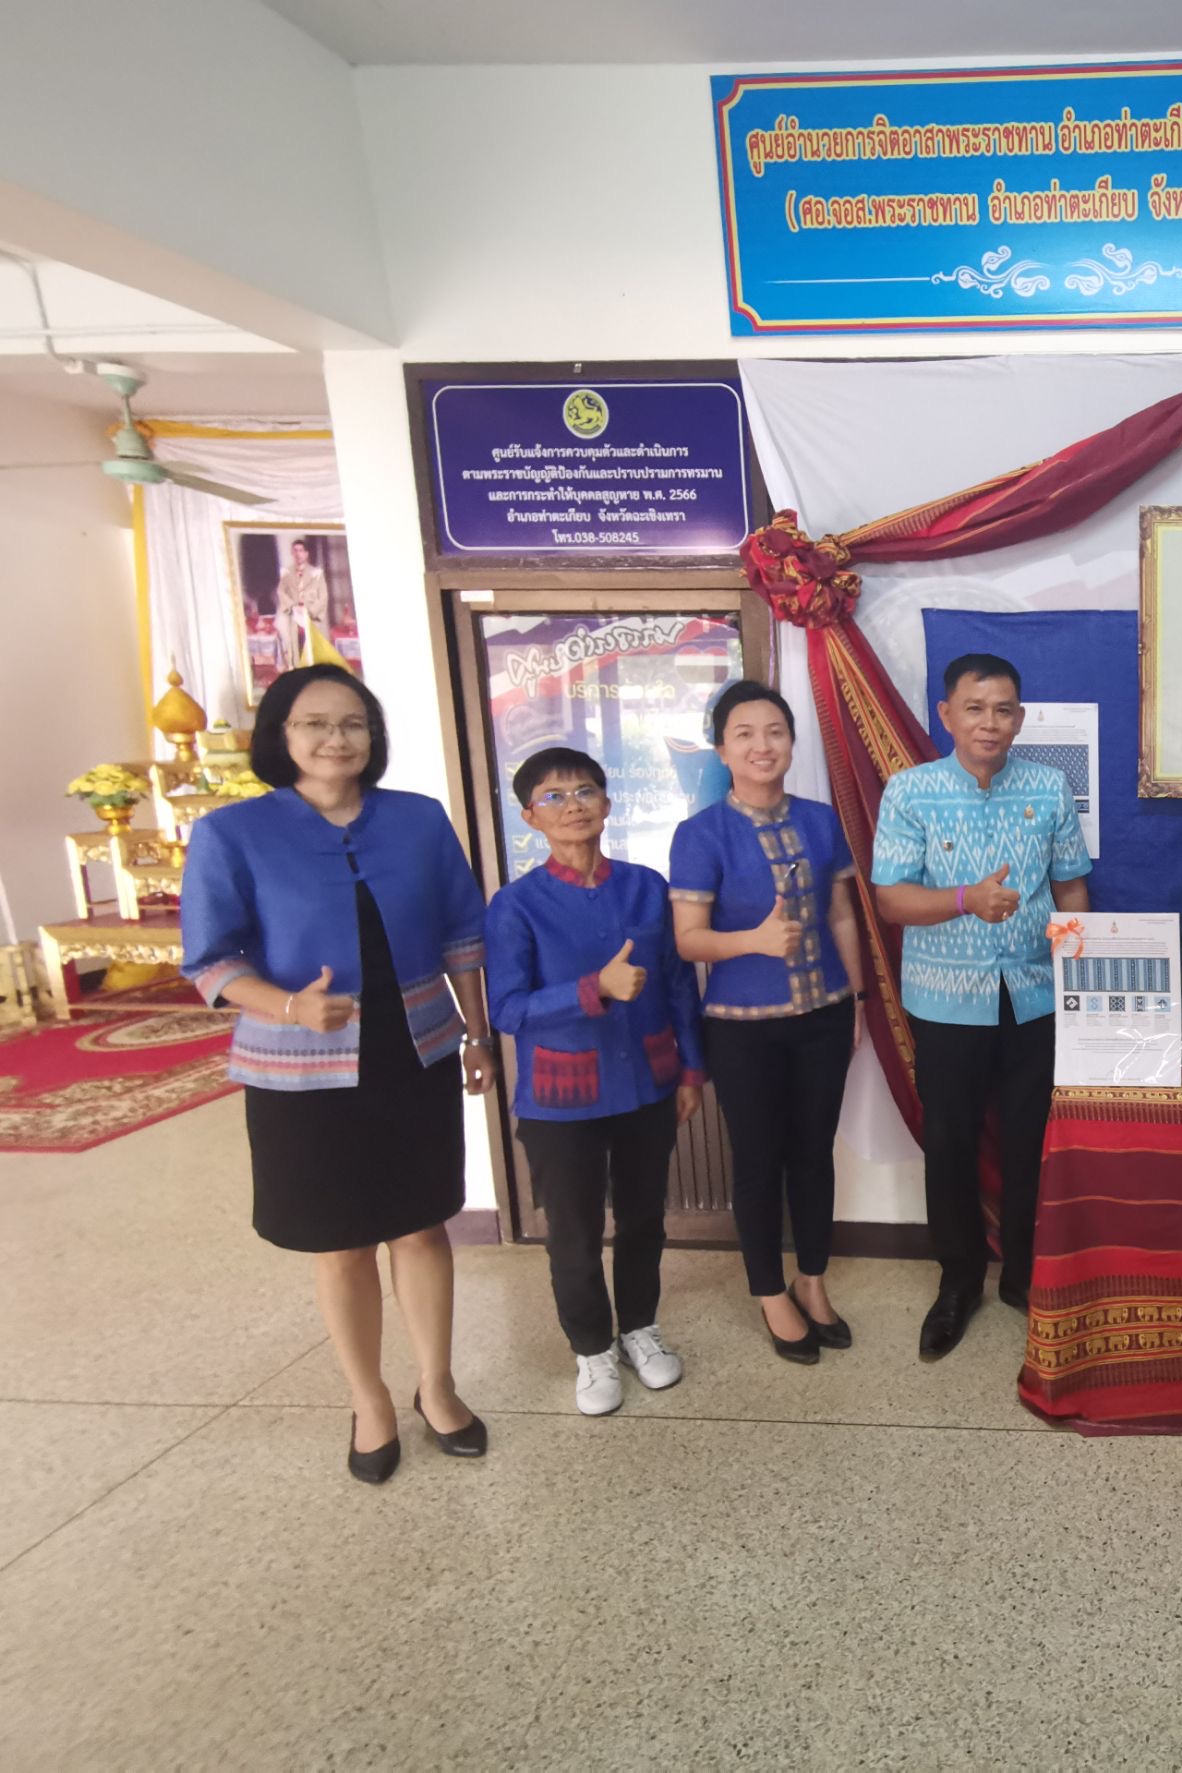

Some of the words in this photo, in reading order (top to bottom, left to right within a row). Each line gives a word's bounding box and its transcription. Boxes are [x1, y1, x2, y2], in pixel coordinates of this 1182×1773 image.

[747, 113, 1054, 177] ศูนย์อำนวยการจิตอาสาพระราชทาน
[989, 175, 1138, 223] อำเภอท่าตะเกียบ
[643, 488, 667, 501] พ.ศ.
[669, 488, 698, 501] 2566
[507, 507, 592, 523] อำเภอท่าตะเกียบ
[598, 506, 687, 524] จังหวัดฉะเชิงเทรา
[551, 529, 640, 544] โทร.038-508245
